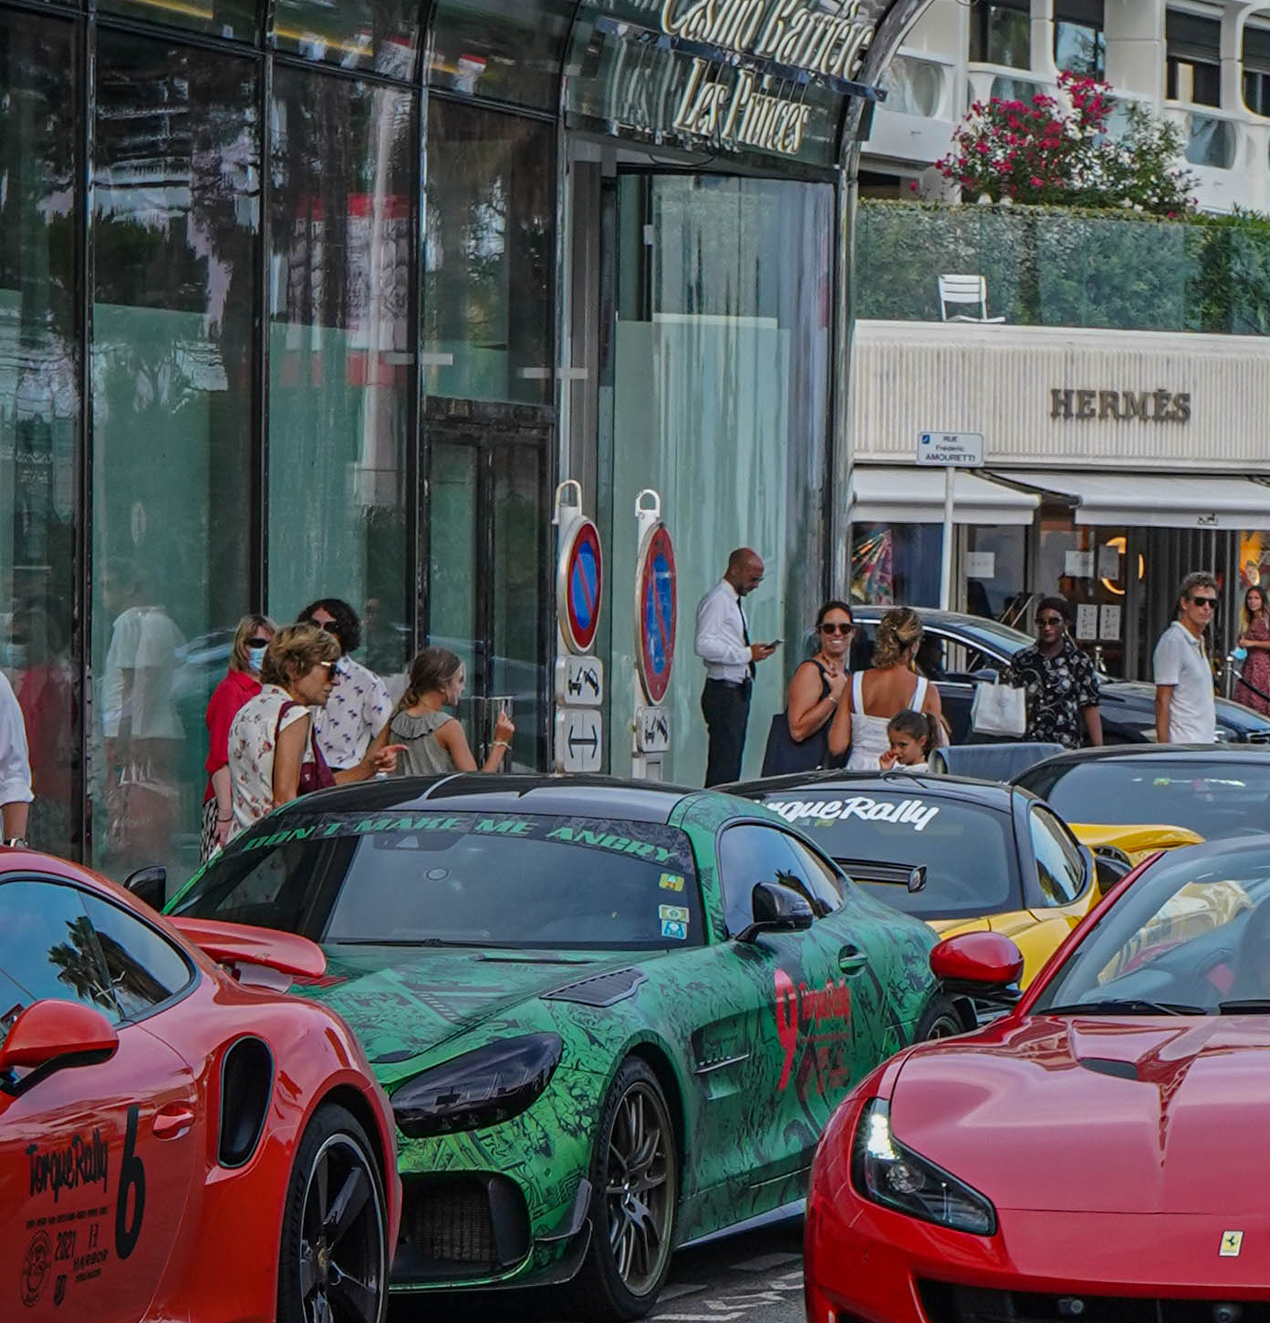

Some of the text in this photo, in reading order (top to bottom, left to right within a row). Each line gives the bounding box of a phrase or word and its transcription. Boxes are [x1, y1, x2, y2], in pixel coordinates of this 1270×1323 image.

[673, 56, 812, 155] Les Princes
[925, 453, 976, 463] AMOURETTI
[242, 816, 678, 863] DON'T MAKE ME ANGRY
[774, 968, 798, 1092] 9
[115, 1104, 146, 1260] 6
